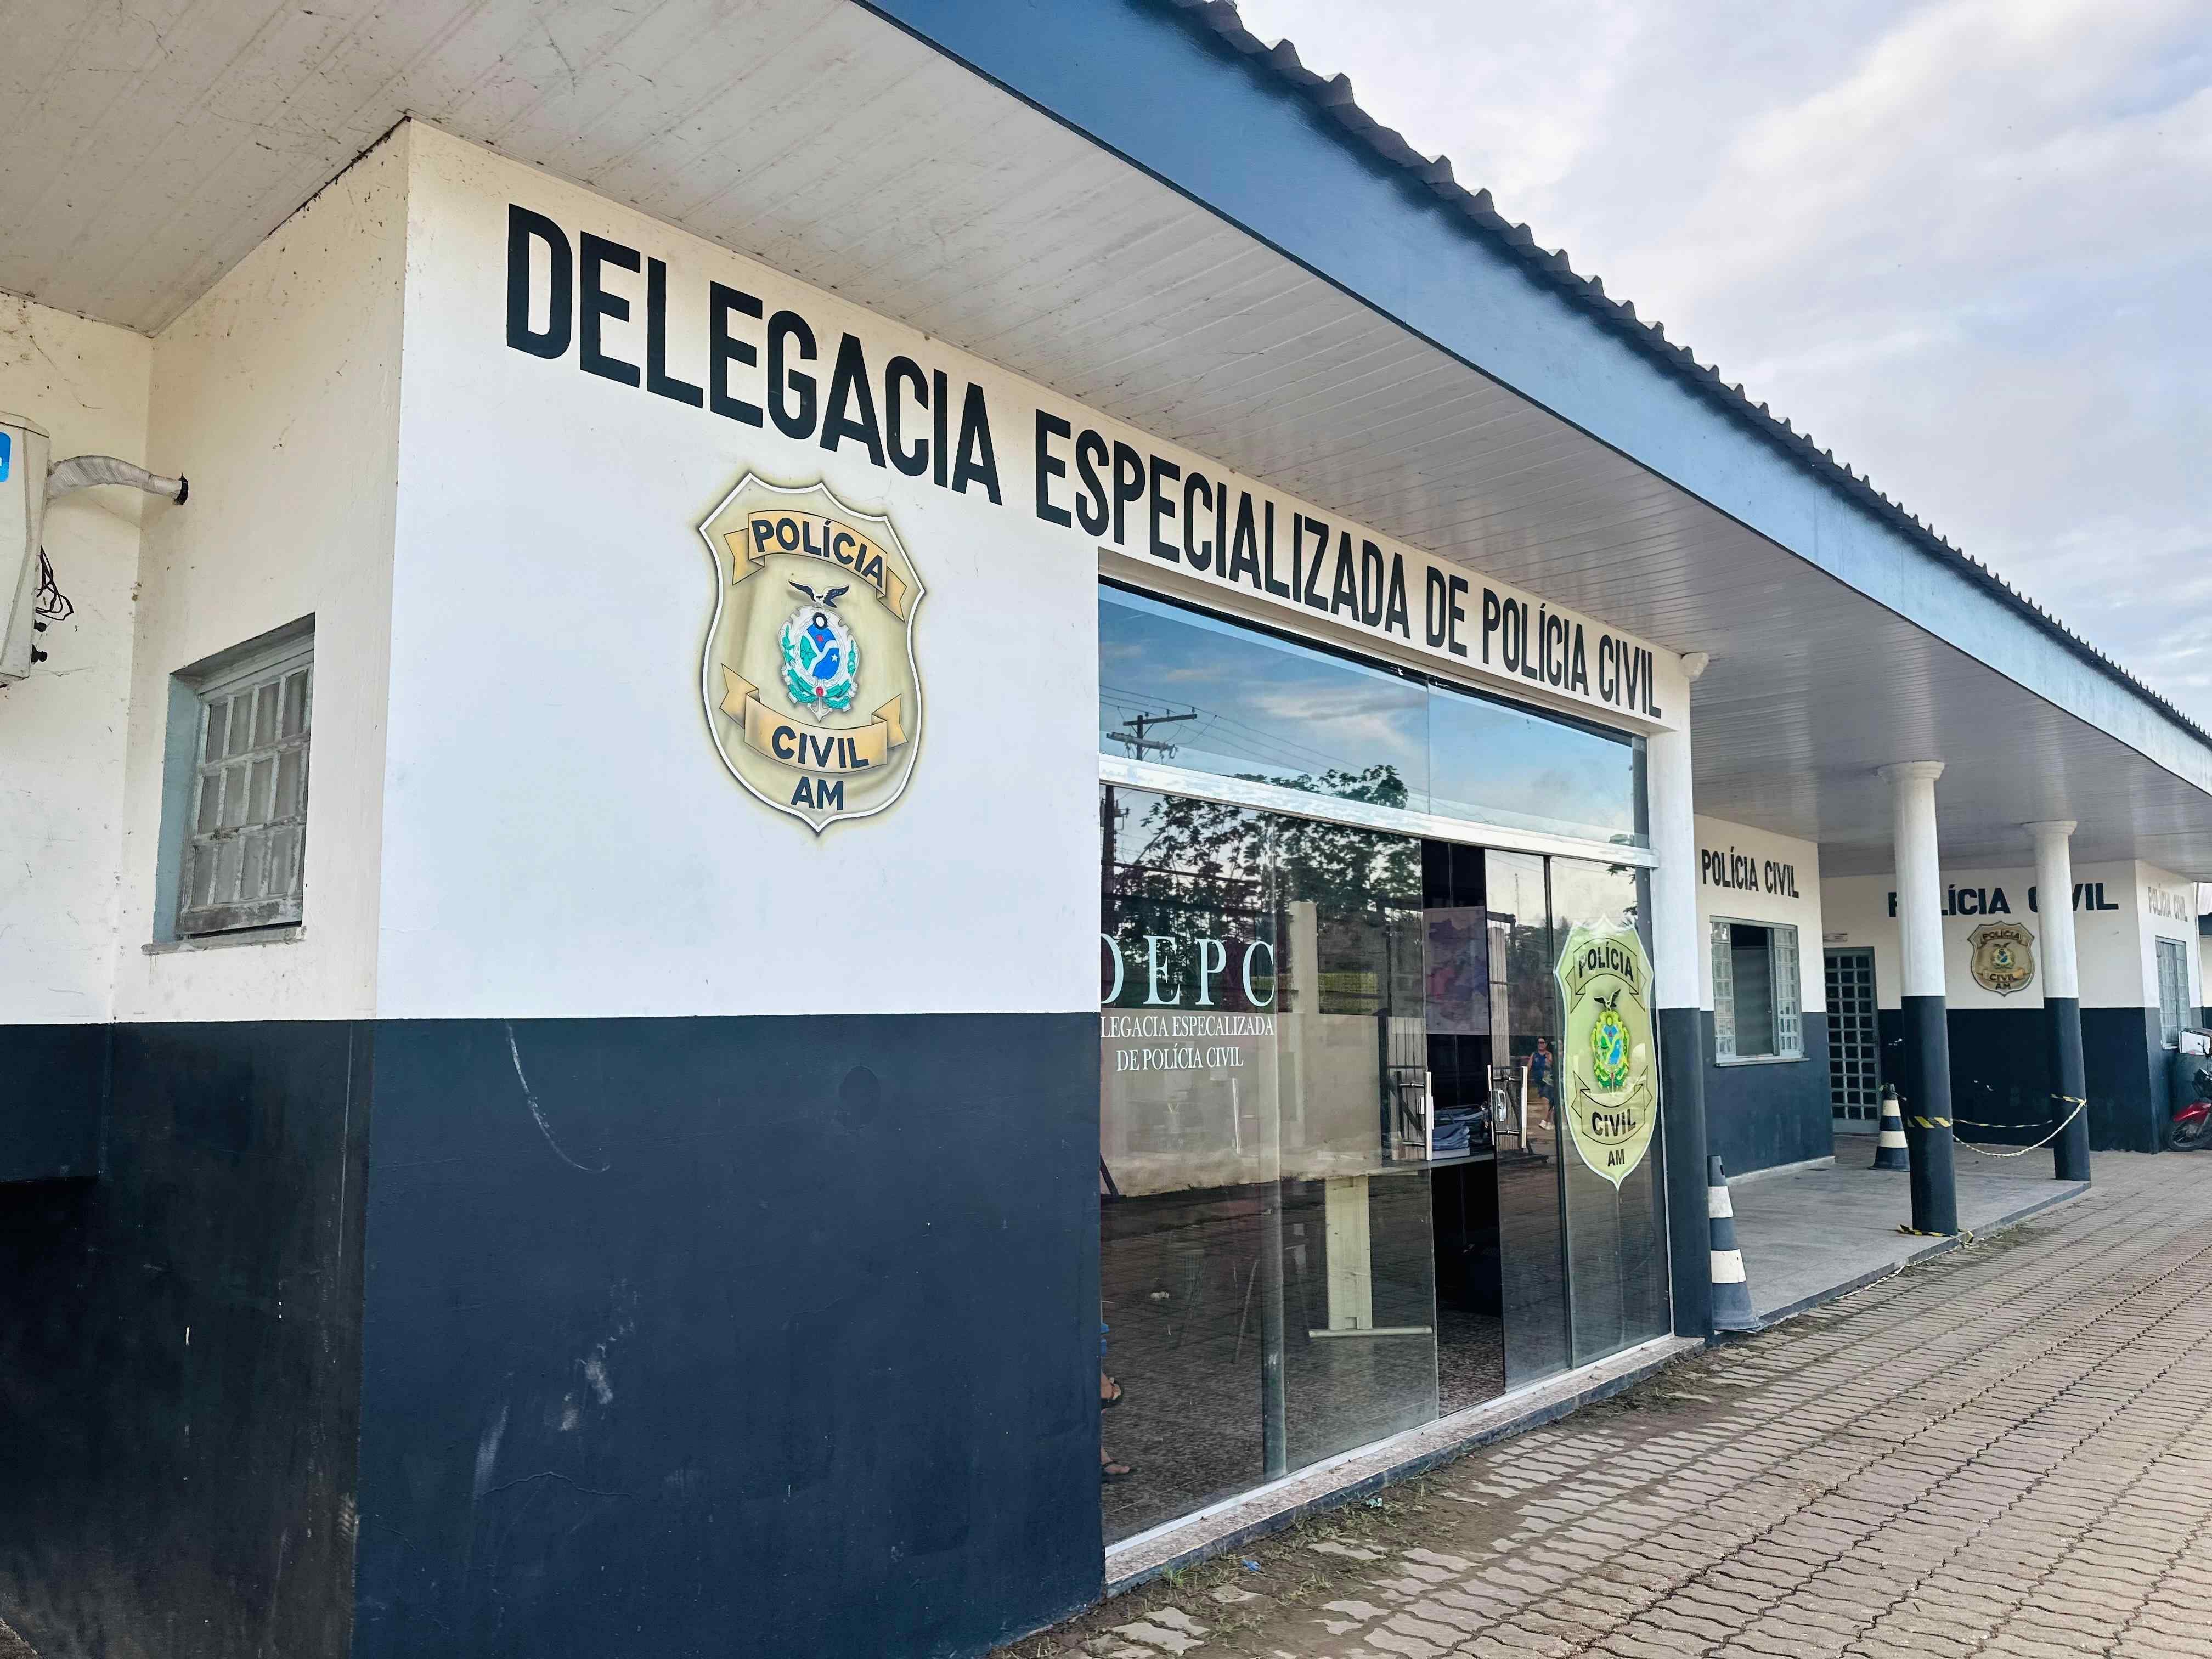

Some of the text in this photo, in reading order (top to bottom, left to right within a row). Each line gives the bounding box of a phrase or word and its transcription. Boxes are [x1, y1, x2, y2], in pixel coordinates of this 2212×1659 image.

[507, 203, 1662, 719] DELEGACIA ESPECIALIZADA DE POLÍCIA CIVIL
[751, 517, 884, 589] POLÍCIA
[771, 725, 870, 770] CIVIL
[790, 776, 845, 811] AM
[1701, 846, 1799, 899] POLÍCIA CIVIL
[1888, 884, 2011, 918] ÍCIA
[1579, 941, 1634, 983] POLÍCIA
[1100, 1015, 1275, 1038] LEGACIA ESPECALIZADA
[1116, 1042, 1244, 1071] DE POLÍCIA CIVIL
[1592, 1108, 1636, 1137] CIVIL
[1607, 1148, 1625, 1167] AM
